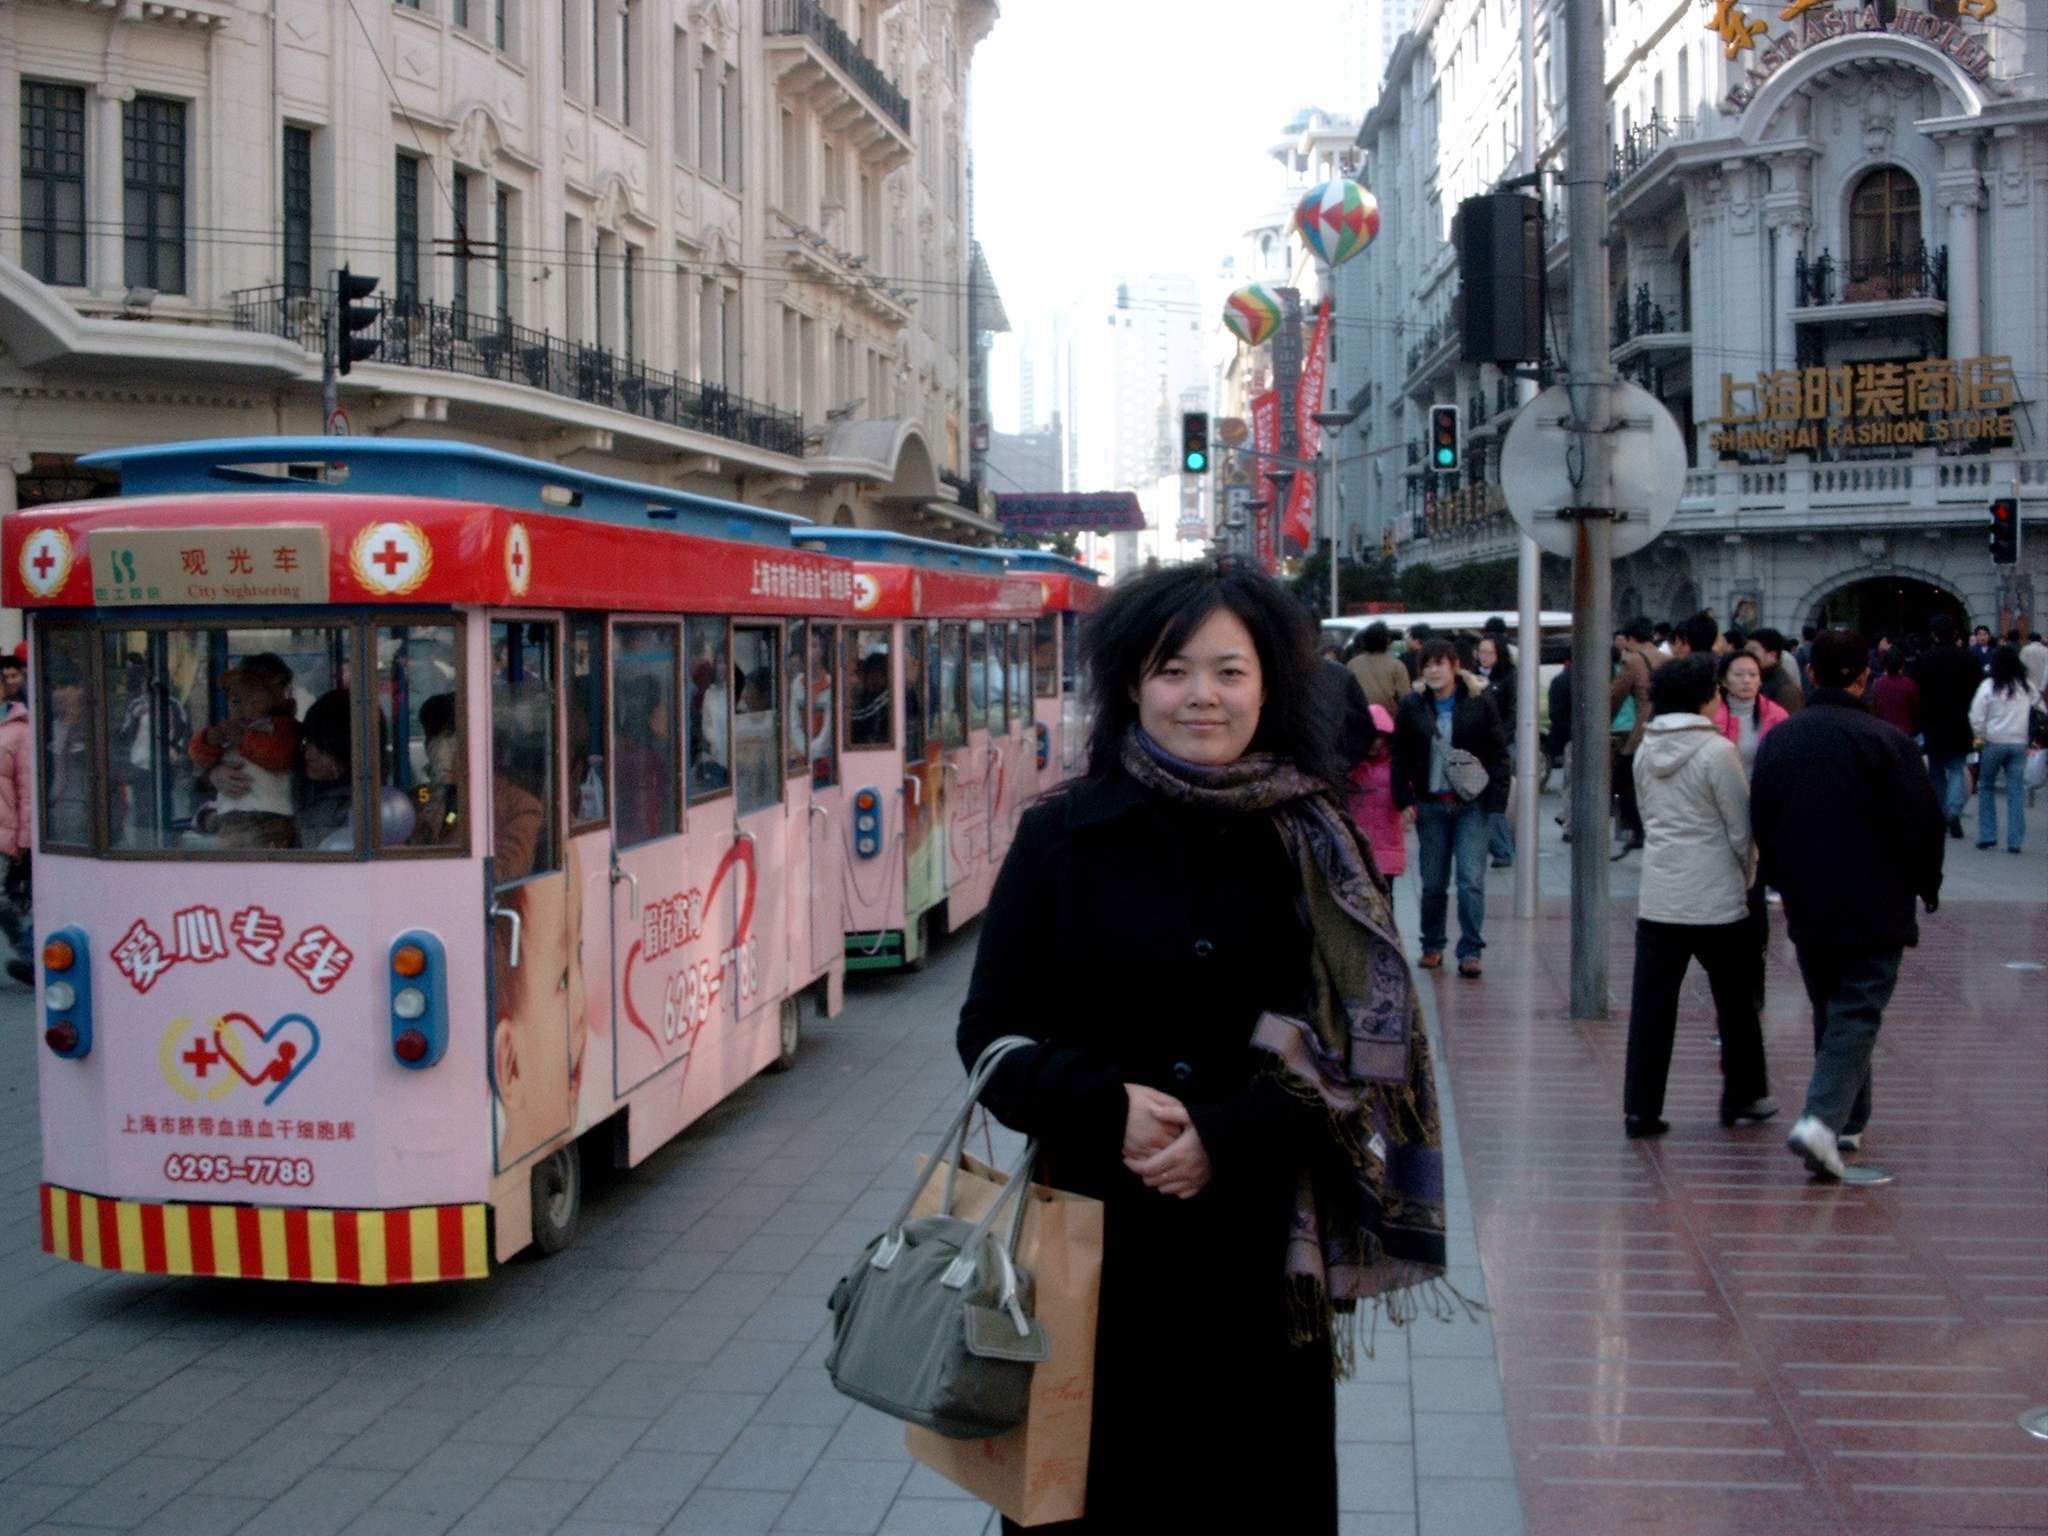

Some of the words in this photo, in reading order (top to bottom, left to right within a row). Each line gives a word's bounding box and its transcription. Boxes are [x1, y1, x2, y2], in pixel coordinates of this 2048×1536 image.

[1726, 29, 1799, 112] EAST
[1803, 4, 1883, 48] ASIA
[1891, 7, 1995, 84] HOTEL
[1709, 355, 2012, 423] 上海时装商店
[1709, 426, 1819, 451] SHANGHAI
[1827, 420, 1926, 446] FASHION
[1936, 415, 2015, 440] STORE
[181, 546, 299, 576] 观光车
[187, 583, 217, 600] City
[221, 582, 301, 599] Sightseeing
[163, 1153, 315, 1188] 6295-7788
